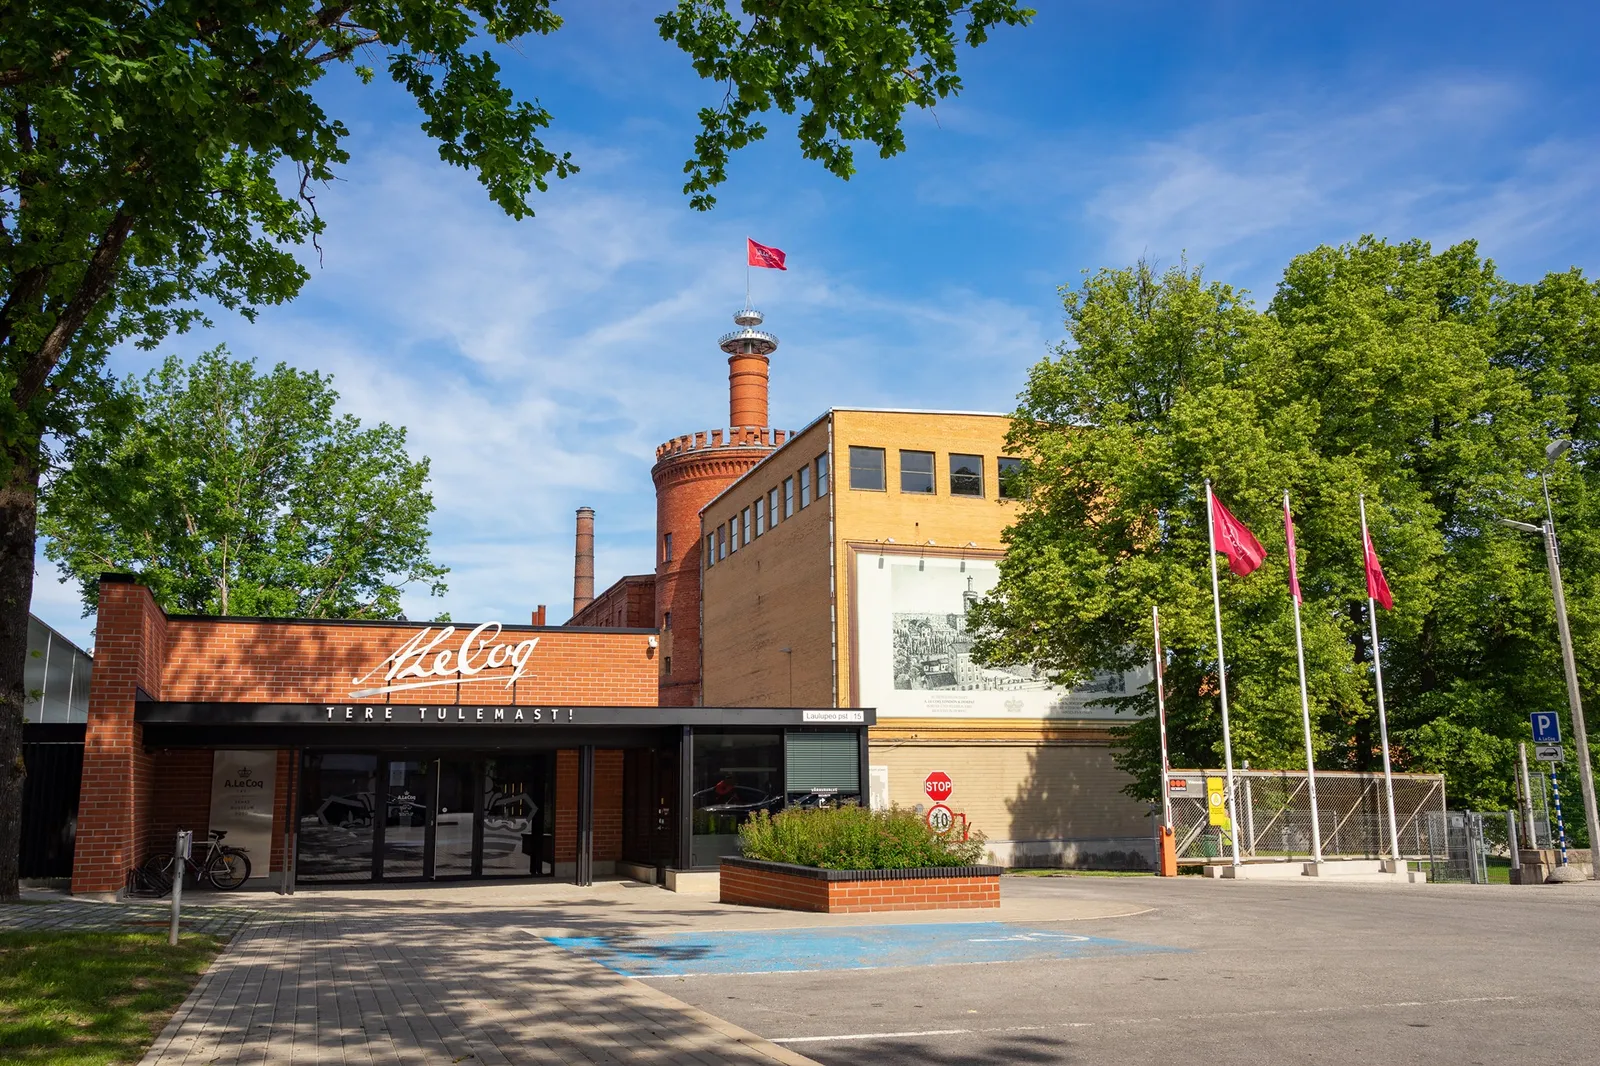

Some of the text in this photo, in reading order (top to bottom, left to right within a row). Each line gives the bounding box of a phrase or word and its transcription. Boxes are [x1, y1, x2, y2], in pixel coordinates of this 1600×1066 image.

[326, 707, 573, 720] TERE TULEMAST!
[806, 712, 837, 720] Laulupeo
[1537, 715, 1551, 736] P
[926, 781, 951, 792] STOP
[933, 812, 949, 827] 10
